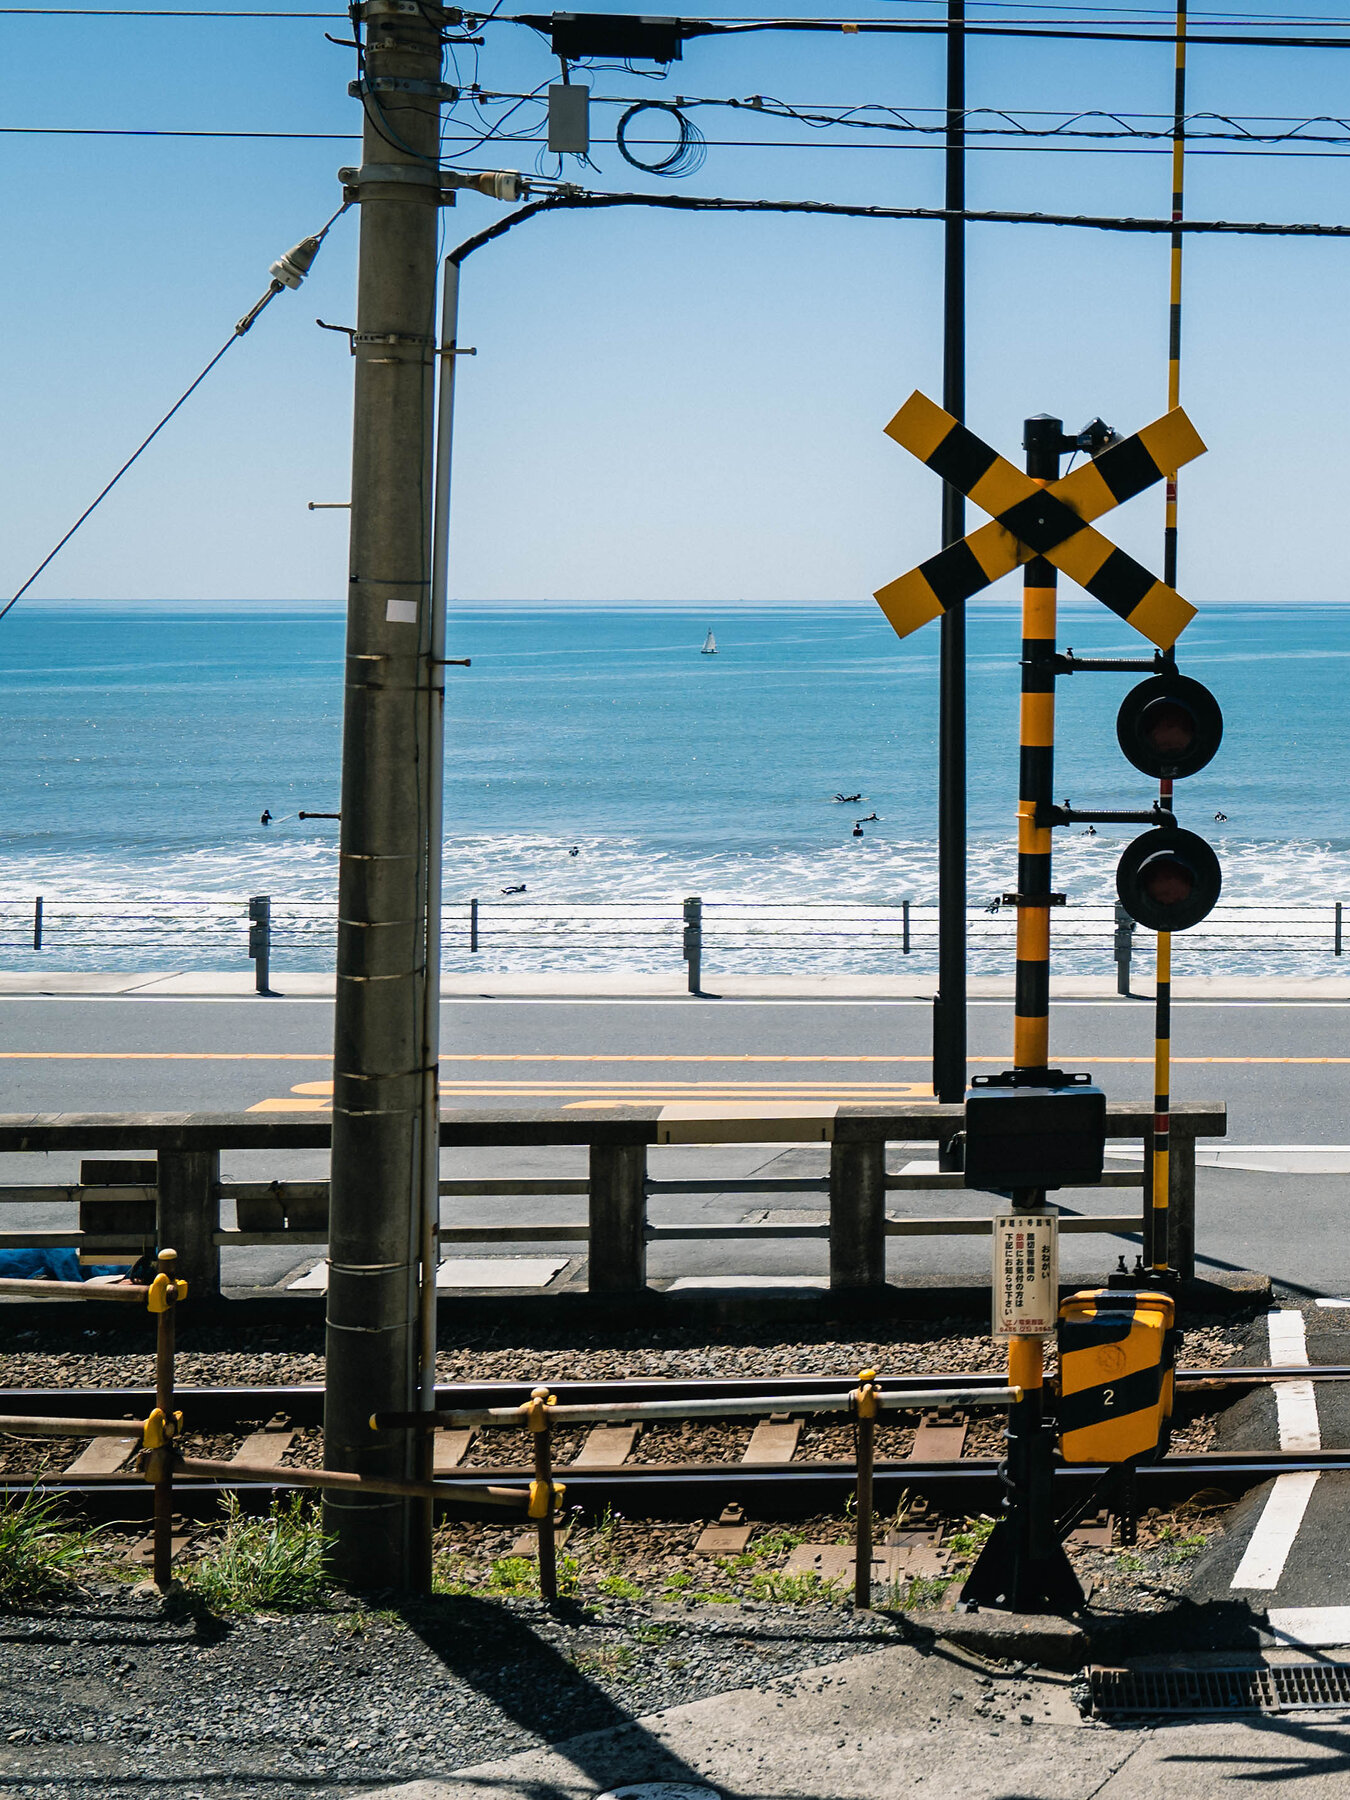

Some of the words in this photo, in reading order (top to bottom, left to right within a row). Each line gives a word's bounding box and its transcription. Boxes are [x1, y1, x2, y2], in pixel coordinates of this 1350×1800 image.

[1005, 1232, 1013, 1316] 下記にお知らせ下さい
[1015, 1232, 1024, 1308] 故障にお気付の方は
[1027, 1233, 1035, 1282] 踏切警報機の
[1042, 1245, 1051, 1279] おねがい
[1103, 1389, 1115, 1405] 2
